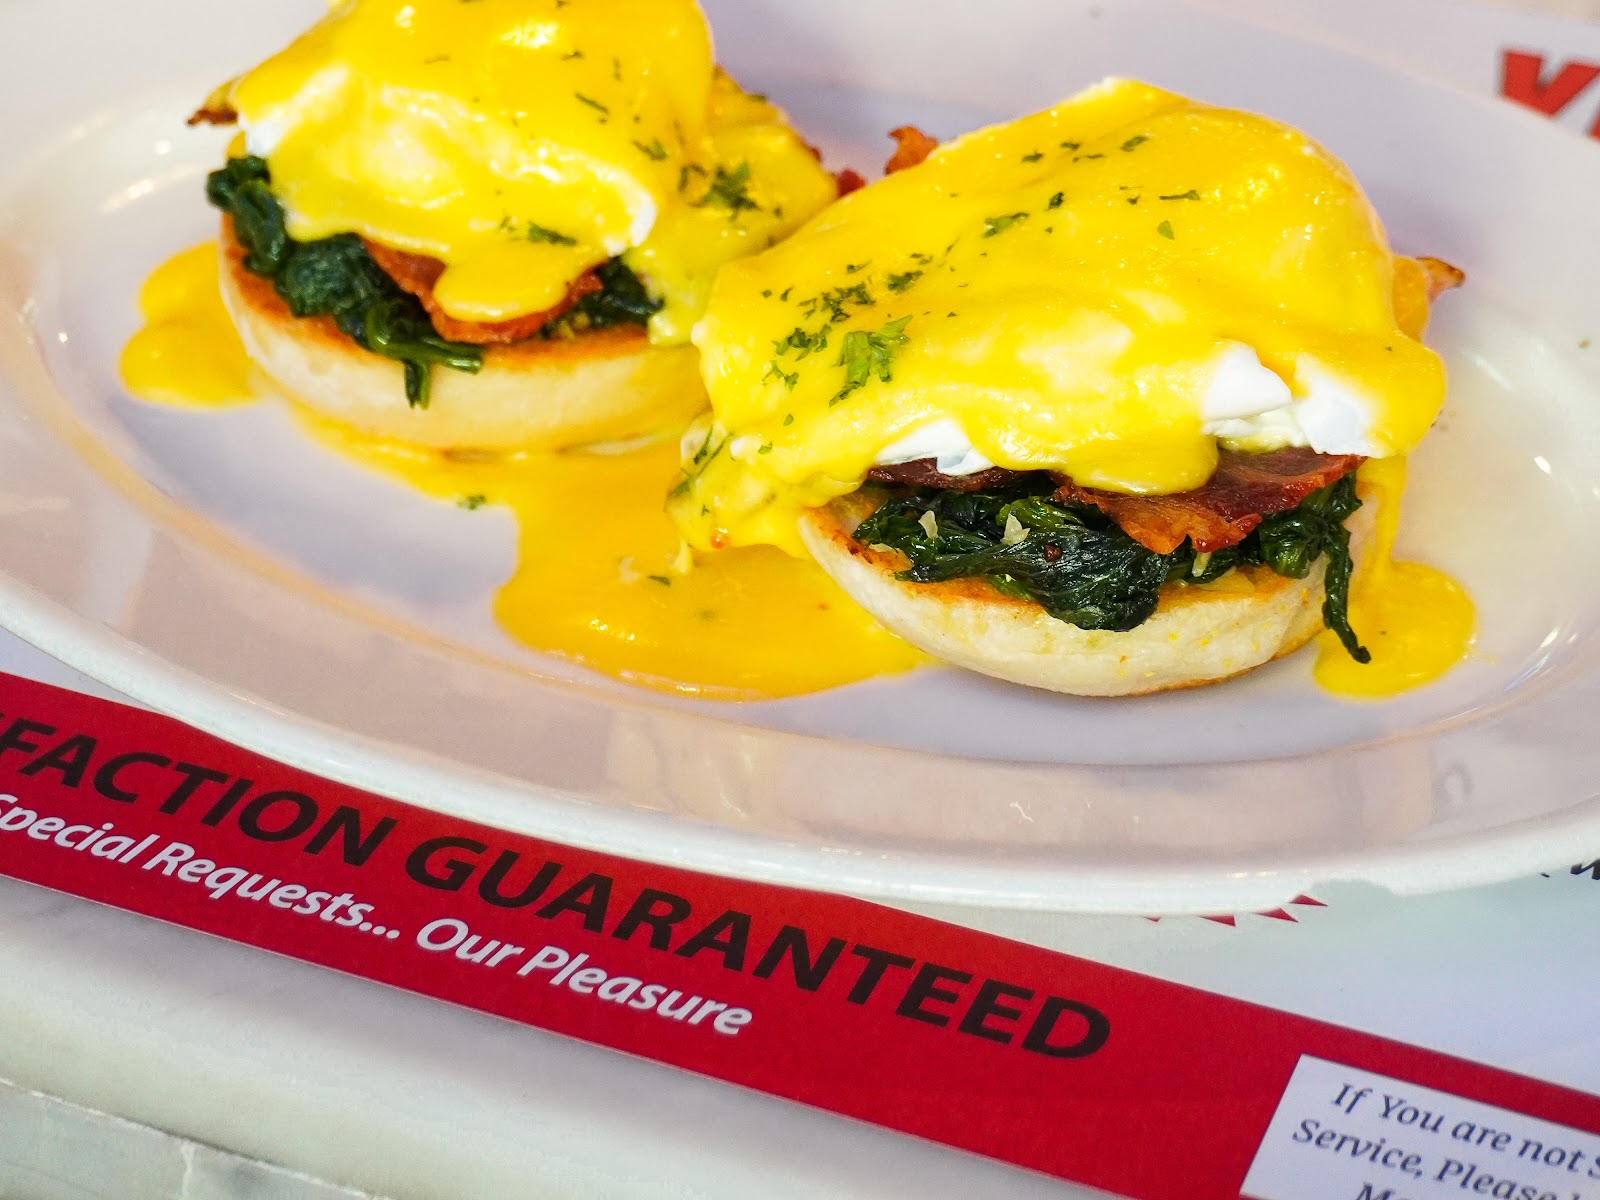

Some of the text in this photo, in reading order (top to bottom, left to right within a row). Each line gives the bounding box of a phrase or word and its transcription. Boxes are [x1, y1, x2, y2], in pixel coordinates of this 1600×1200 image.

[0, 712, 1111, 1061] FACTION GUARANTEED
[141, 841, 400, 939] Requests...
[416, 917, 525, 969] Our
[516, 944, 753, 1036] Pleasure
[1291, 1117, 1423, 1180] Service,
[1331, 1081, 1373, 1115] If
[1379, 1094, 1445, 1134] You
[1450, 1120, 1513, 1152] are
[1517, 1137, 1586, 1173] not
